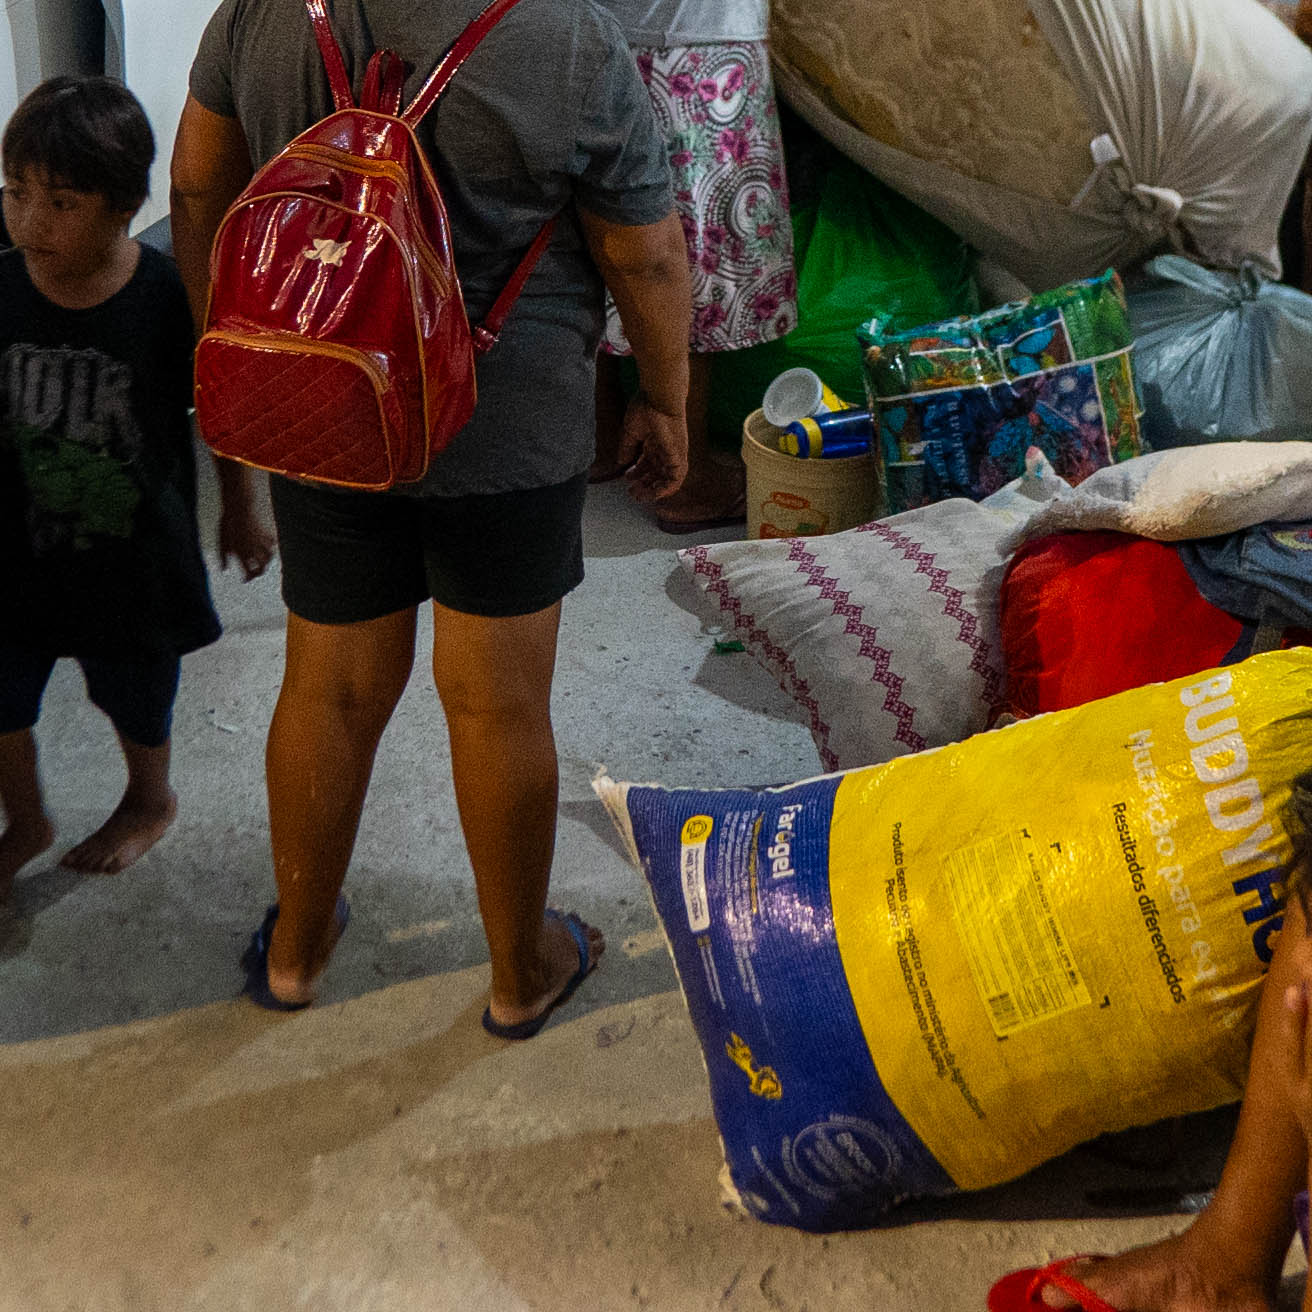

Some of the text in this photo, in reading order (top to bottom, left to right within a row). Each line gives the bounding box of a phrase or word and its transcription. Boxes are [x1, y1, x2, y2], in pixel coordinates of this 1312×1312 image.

[1179, 669, 1281, 867] BUDDY
[892, 821, 905, 866] Produto
[1128, 728, 1202, 935] Nutrição para
[896, 866, 908, 903] isento
[1111, 801, 1187, 1005] Resultados diferenciados
[896, 940, 929, 1032] Abastecimento
[916, 971, 929, 988] no
